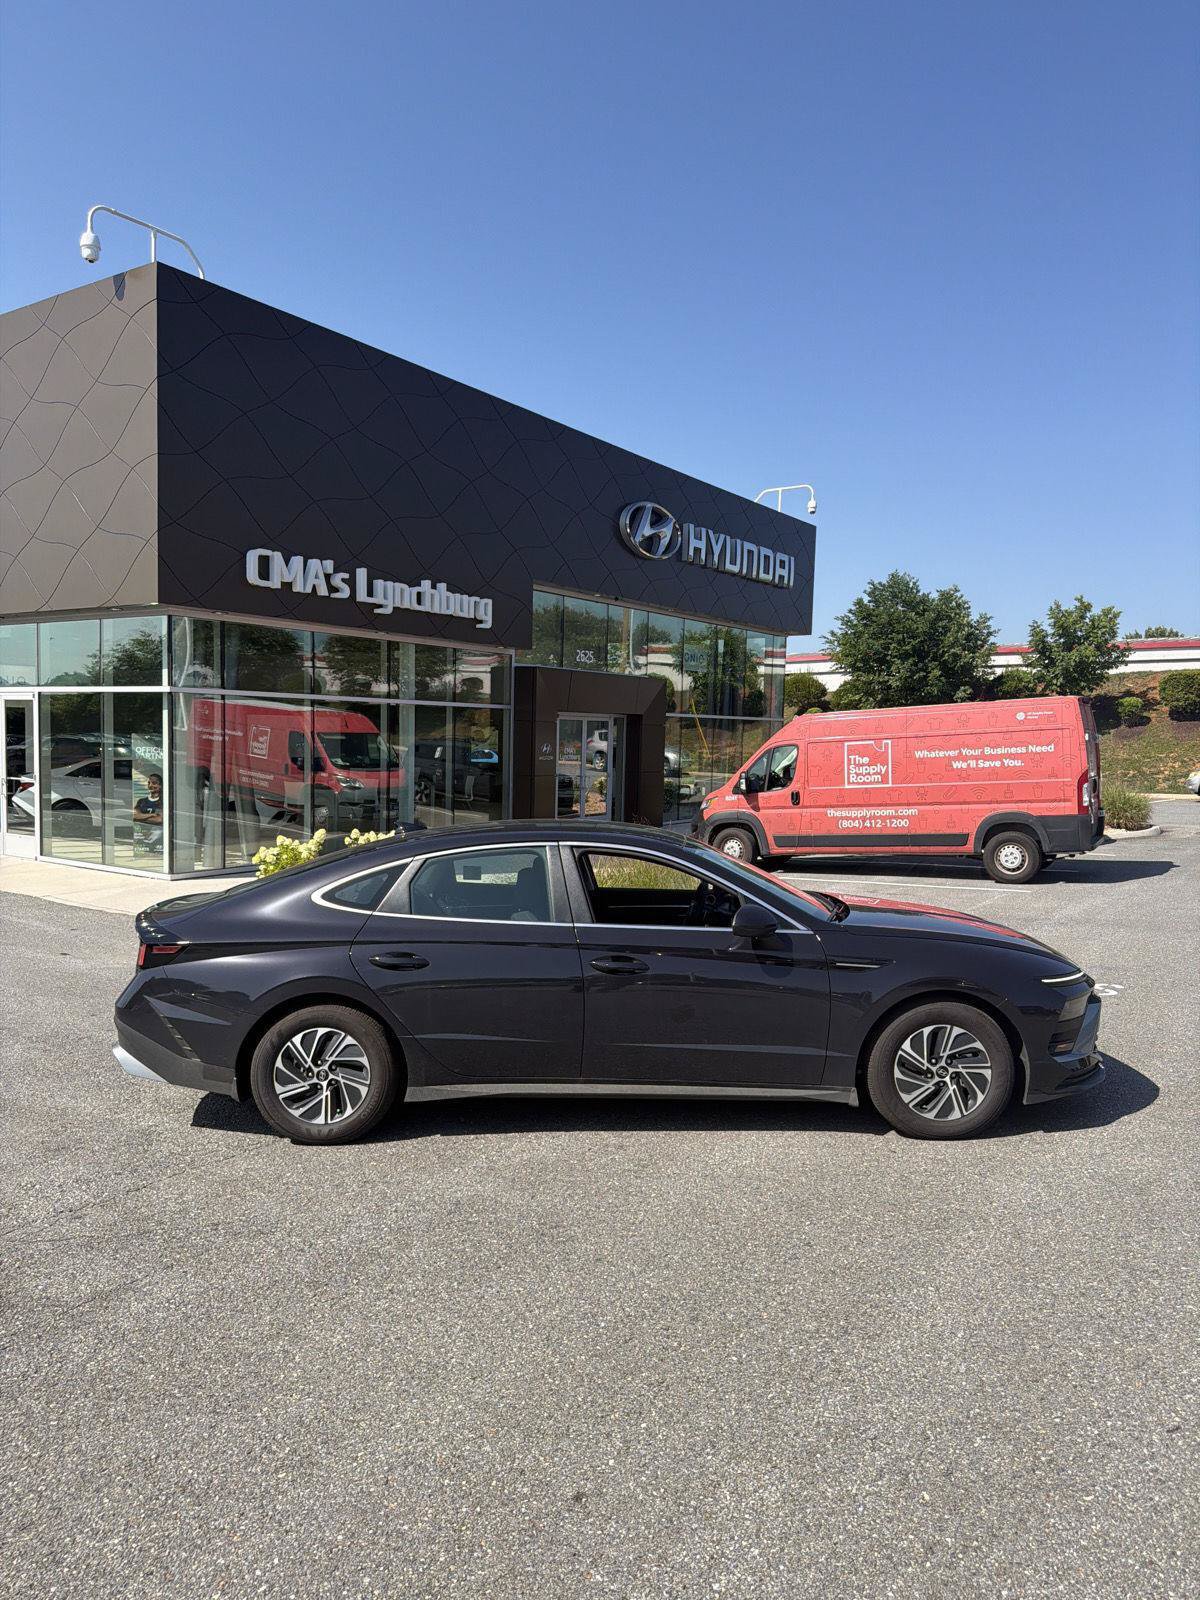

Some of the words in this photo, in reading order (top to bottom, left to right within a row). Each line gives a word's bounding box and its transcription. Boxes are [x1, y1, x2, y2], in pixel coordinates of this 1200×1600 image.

[682, 522, 795, 589] HYUNDAI
[246, 548, 350, 598] CMA's
[356, 567, 492, 629] Lynchburg
[576, 649, 594, 663] 2625
[914, 750, 959, 759] Whatever
[961, 747, 981, 756] Your
[984, 745, 1026, 755] Business
[1029, 743, 1055, 753] Need
[849, 755, 870, 764] The
[952, 759, 976, 769] We'll
[978, 759, 1001, 768] Save
[1003, 758, 1025, 767] You.
[849, 764, 887, 775] Supply
[849, 774, 882, 783] Room
[827, 808, 918, 817] thesupplyroom.com
[838, 819, 863, 829] (804)
[864, 819, 909, 828] 412-1200
